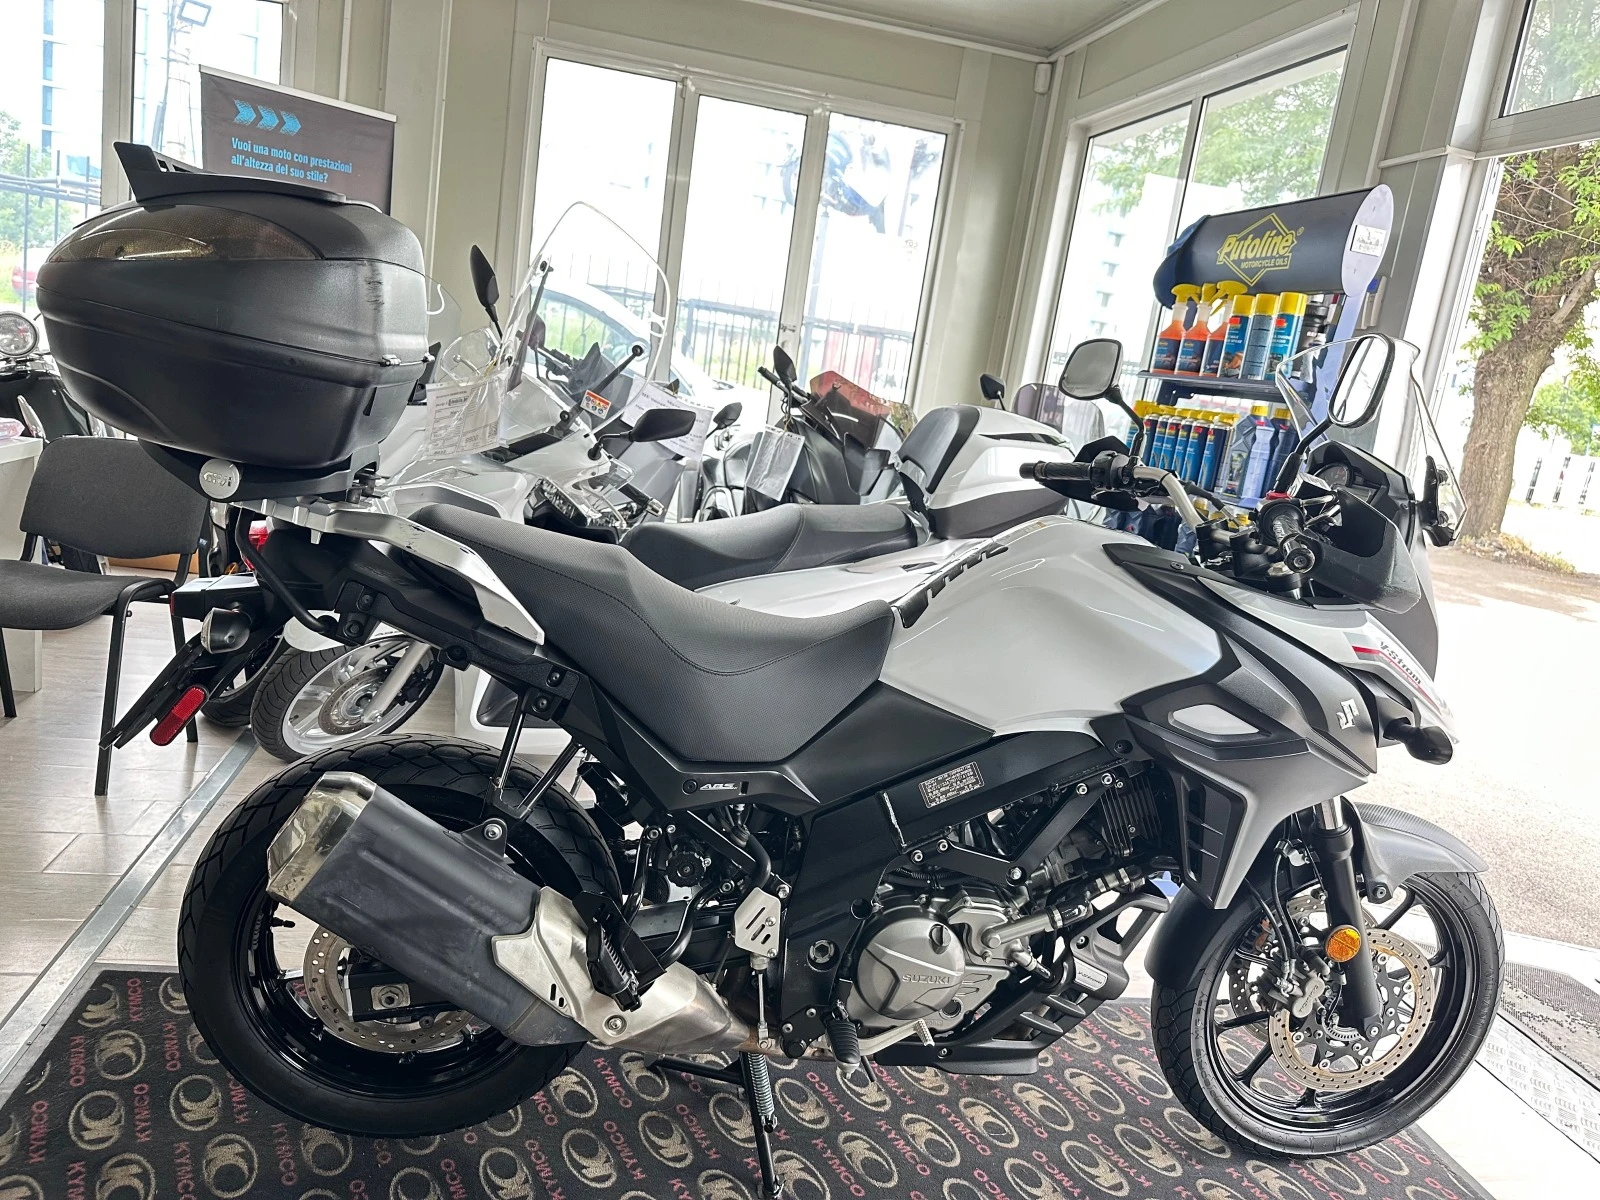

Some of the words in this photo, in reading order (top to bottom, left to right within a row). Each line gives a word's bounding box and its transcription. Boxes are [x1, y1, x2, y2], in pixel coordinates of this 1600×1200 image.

[231, 137, 251, 151] Vuoi
[253, 143, 269, 155] una
[271, 148, 291, 160] moto
[293, 153, 309, 165] con
[310, 156, 352, 173] prestazioni
[231, 154, 274, 172] all'altezza
[275, 162, 288, 175] del
[290, 168, 304, 179] suo
[306, 170, 329, 183] stile?
[1219, 230, 1293, 261] Putoline
[1241, 259, 1275, 269] MOTORCYCLE
[1275, 257, 1288, 266] OILS
[1380, 640, 1422, 685] V-Strom
[700, 782, 736, 791] ABS
[127, 978, 143, 1022] KYMCO
[902, 974, 950, 985] SUZUKI
[163, 1021, 181, 1071] KYMCO
[1080, 1019, 1121, 1049] KYMC
[1236, 1029, 1264, 1050] YMC
[69, 1035, 85, 1087] KYMCO
[593, 1057, 633, 1108] KYMCO
[871, 1062, 915, 1105] KYMC
[1092, 1059, 1151, 1106] KYMCO
[133, 1083, 151, 1142] KYMCO
[228, 1074, 249, 1124] KYMC
[532, 1089, 559, 1126] MCO
[806, 1072, 854, 1123] KYMCO
[991, 1088, 1048, 1139] KYMCO
[1042, 1074, 1100, 1122] KYMCO
[28, 1100, 49, 1164] KYMCO
[603, 1120, 647, 1180] KYMCO
[675, 1103, 721, 1160] KYMCO
[876, 1120, 931, 1176] KYMCO
[936, 1103, 992, 1157] KYMCO
[1139, 1116, 1203, 1170] KYMCO
[1390, 1138, 1432, 1166] MCO
[67, 1161, 86, 1200] KYM
[174, 1141, 197, 1200] KYMC
[440, 1158, 467, 1199] MCO
[525, 1139, 565, 1200] KYMCO
[811, 1138, 865, 1197] KYMCO
[1032, 1150, 1089, 1200] YMCO
[1088, 1133, 1152, 1187] KYMCO
[1226, 1167, 1268, 1200] KYM
[1289, 1161, 1345, 1200] YMCO
[1347, 1152, 1391, 1184] MCO
